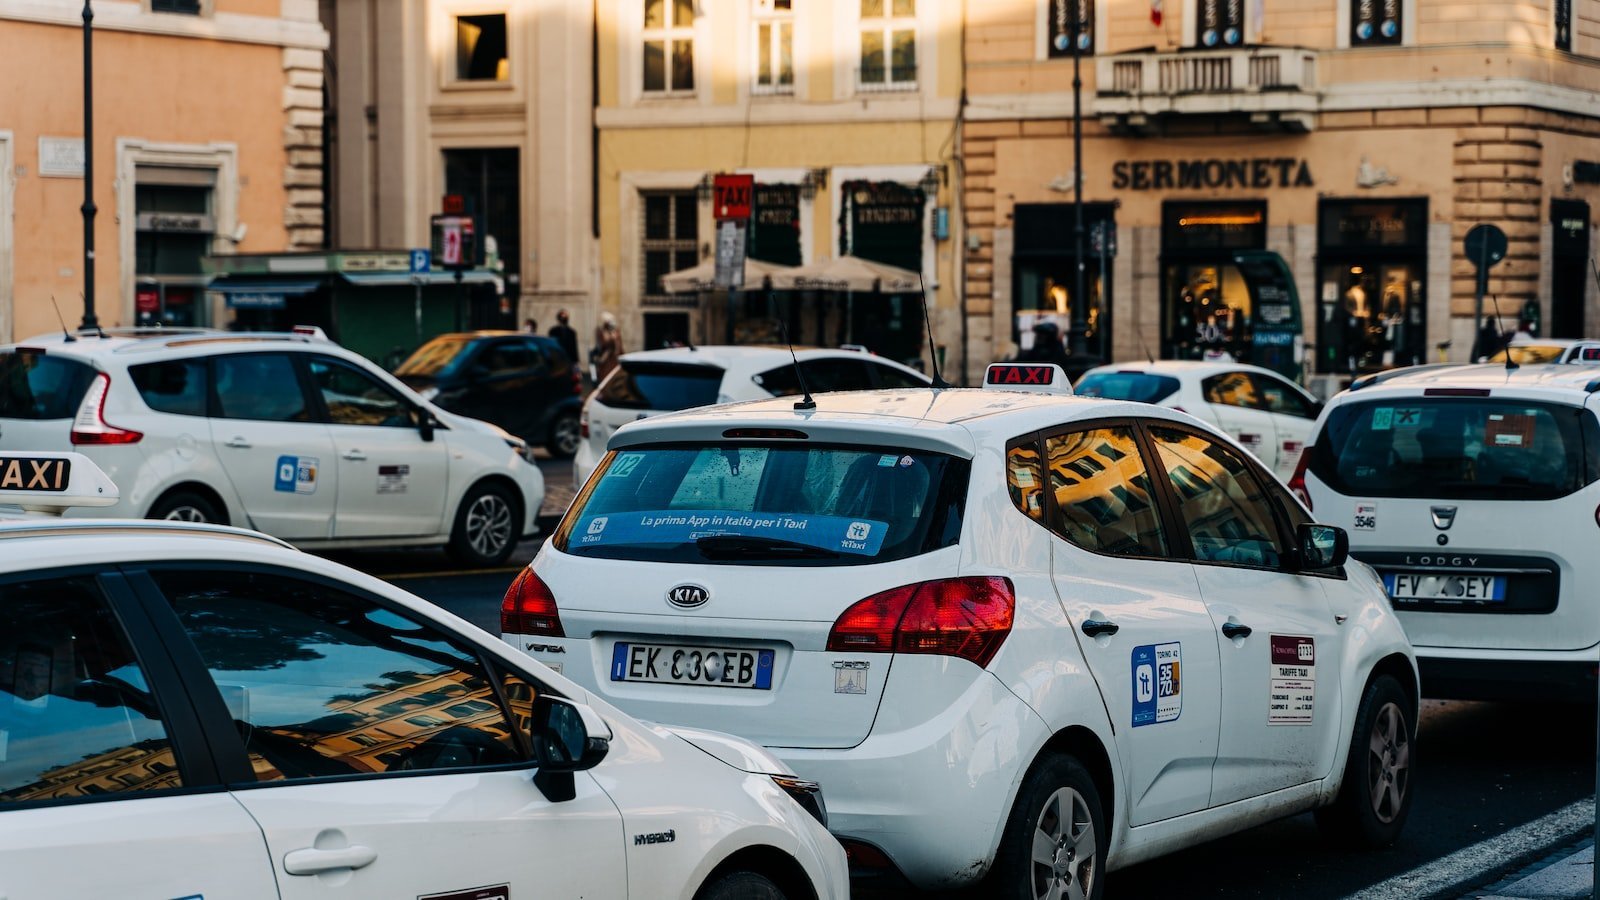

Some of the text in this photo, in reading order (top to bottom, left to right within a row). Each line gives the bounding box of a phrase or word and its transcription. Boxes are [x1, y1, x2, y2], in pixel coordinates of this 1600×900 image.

[1112, 157, 1314, 190] SERMONETA
[717, 186, 751, 206] TAXI
[990, 367, 1051, 383] TAXI
[612, 455, 641, 475] 02
[0, 459, 64, 488] AXI
[640, 515, 808, 530] La prima App in Italia per i Taxi
[1354, 515, 1375, 528] 3546
[1406, 556, 1478, 566] LODGY
[674, 588, 701, 602] KIA
[1157, 650, 1171, 659] TORINO
[1160, 664, 1172, 681] 35
[1279, 668, 1308, 677] TARIFFE TAXI
